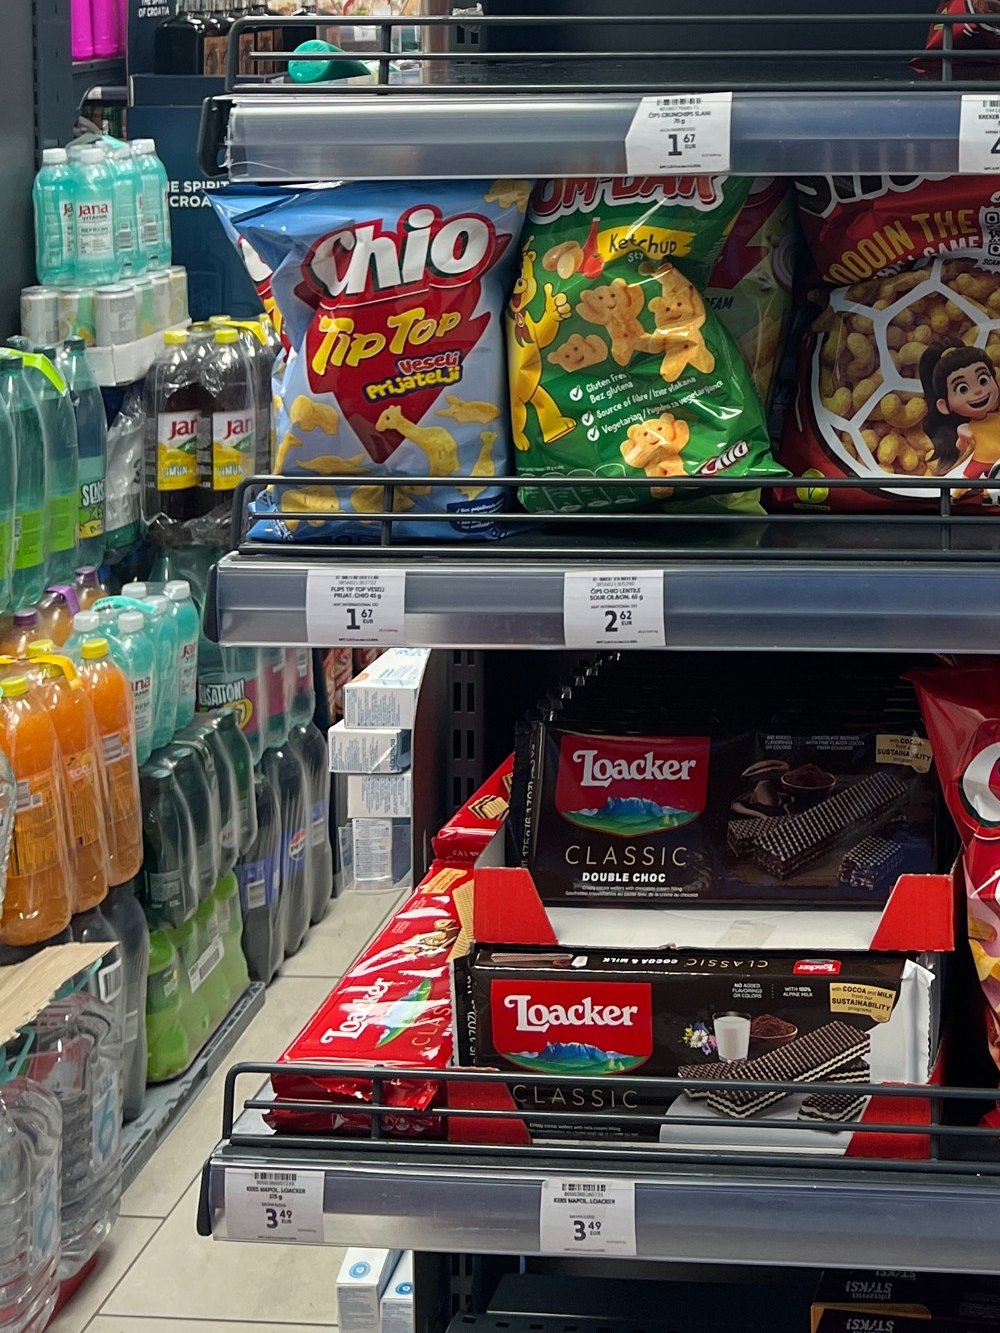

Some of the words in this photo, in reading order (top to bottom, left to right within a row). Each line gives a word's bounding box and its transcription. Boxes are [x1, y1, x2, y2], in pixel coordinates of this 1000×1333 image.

[668, 134, 682, 156] 1
[683, 134, 696, 143] 67
[78, 202, 109, 218] Jana
[911, 209, 978, 243] THE
[310, 206, 497, 297] Chio
[609, 232, 678, 256] Ketchup
[586, 377, 611, 394] Gluten
[589, 394, 606, 404] Bez
[607, 381, 634, 400] glutena
[596, 403, 622, 420] Source
[669, 376, 697, 391] vlakana
[347, 609, 360, 630] 1
[361, 609, 373, 618] 67
[605, 610, 618, 633] 2
[620, 610, 632, 620] 62
[573, 748, 697, 788] Loacker
[565, 844, 688, 868] CLASSIC
[582, 872, 629, 882] DOUBLE
[632, 873, 666, 883] CHOC
[686, 958, 769, 968] CLASSIC
[842, 986, 867, 995] COCOA
[877, 991, 893, 999] MILK
[503, 992, 640, 1033] Loacker
[831, 997, 892, 1012] SUSTAINABILITY
[512, 1084, 638, 1109] CLASSIC
[266, 1208, 278, 1229] 3
[280, 1210, 293, 1218] 49
[574, 1220, 586, 1241] 3
[588, 1222, 602, 1230] 49
